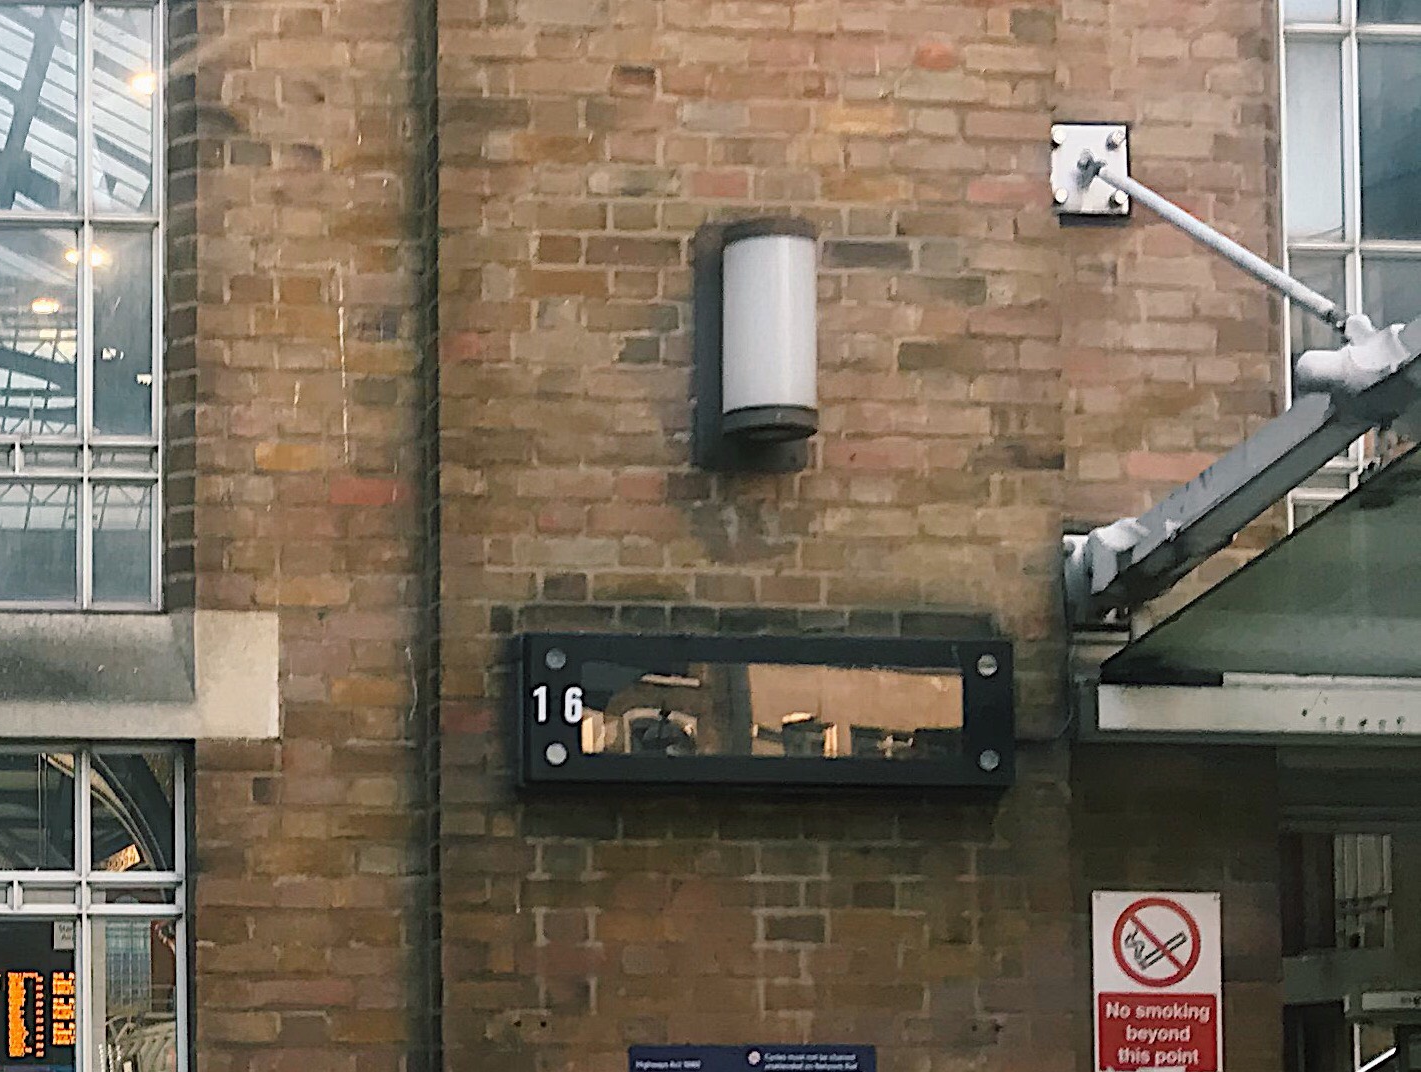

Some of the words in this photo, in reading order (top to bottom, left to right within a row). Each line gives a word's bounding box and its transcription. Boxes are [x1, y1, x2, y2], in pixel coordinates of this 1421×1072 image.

[1105, 1002, 1131, 1019] No
[1135, 1002, 1210, 1023] smoking
[1125, 1025, 1191, 1045] beyond
[1118, 1047, 1151, 1065] this
[1155, 1047, 1199, 1068] point
